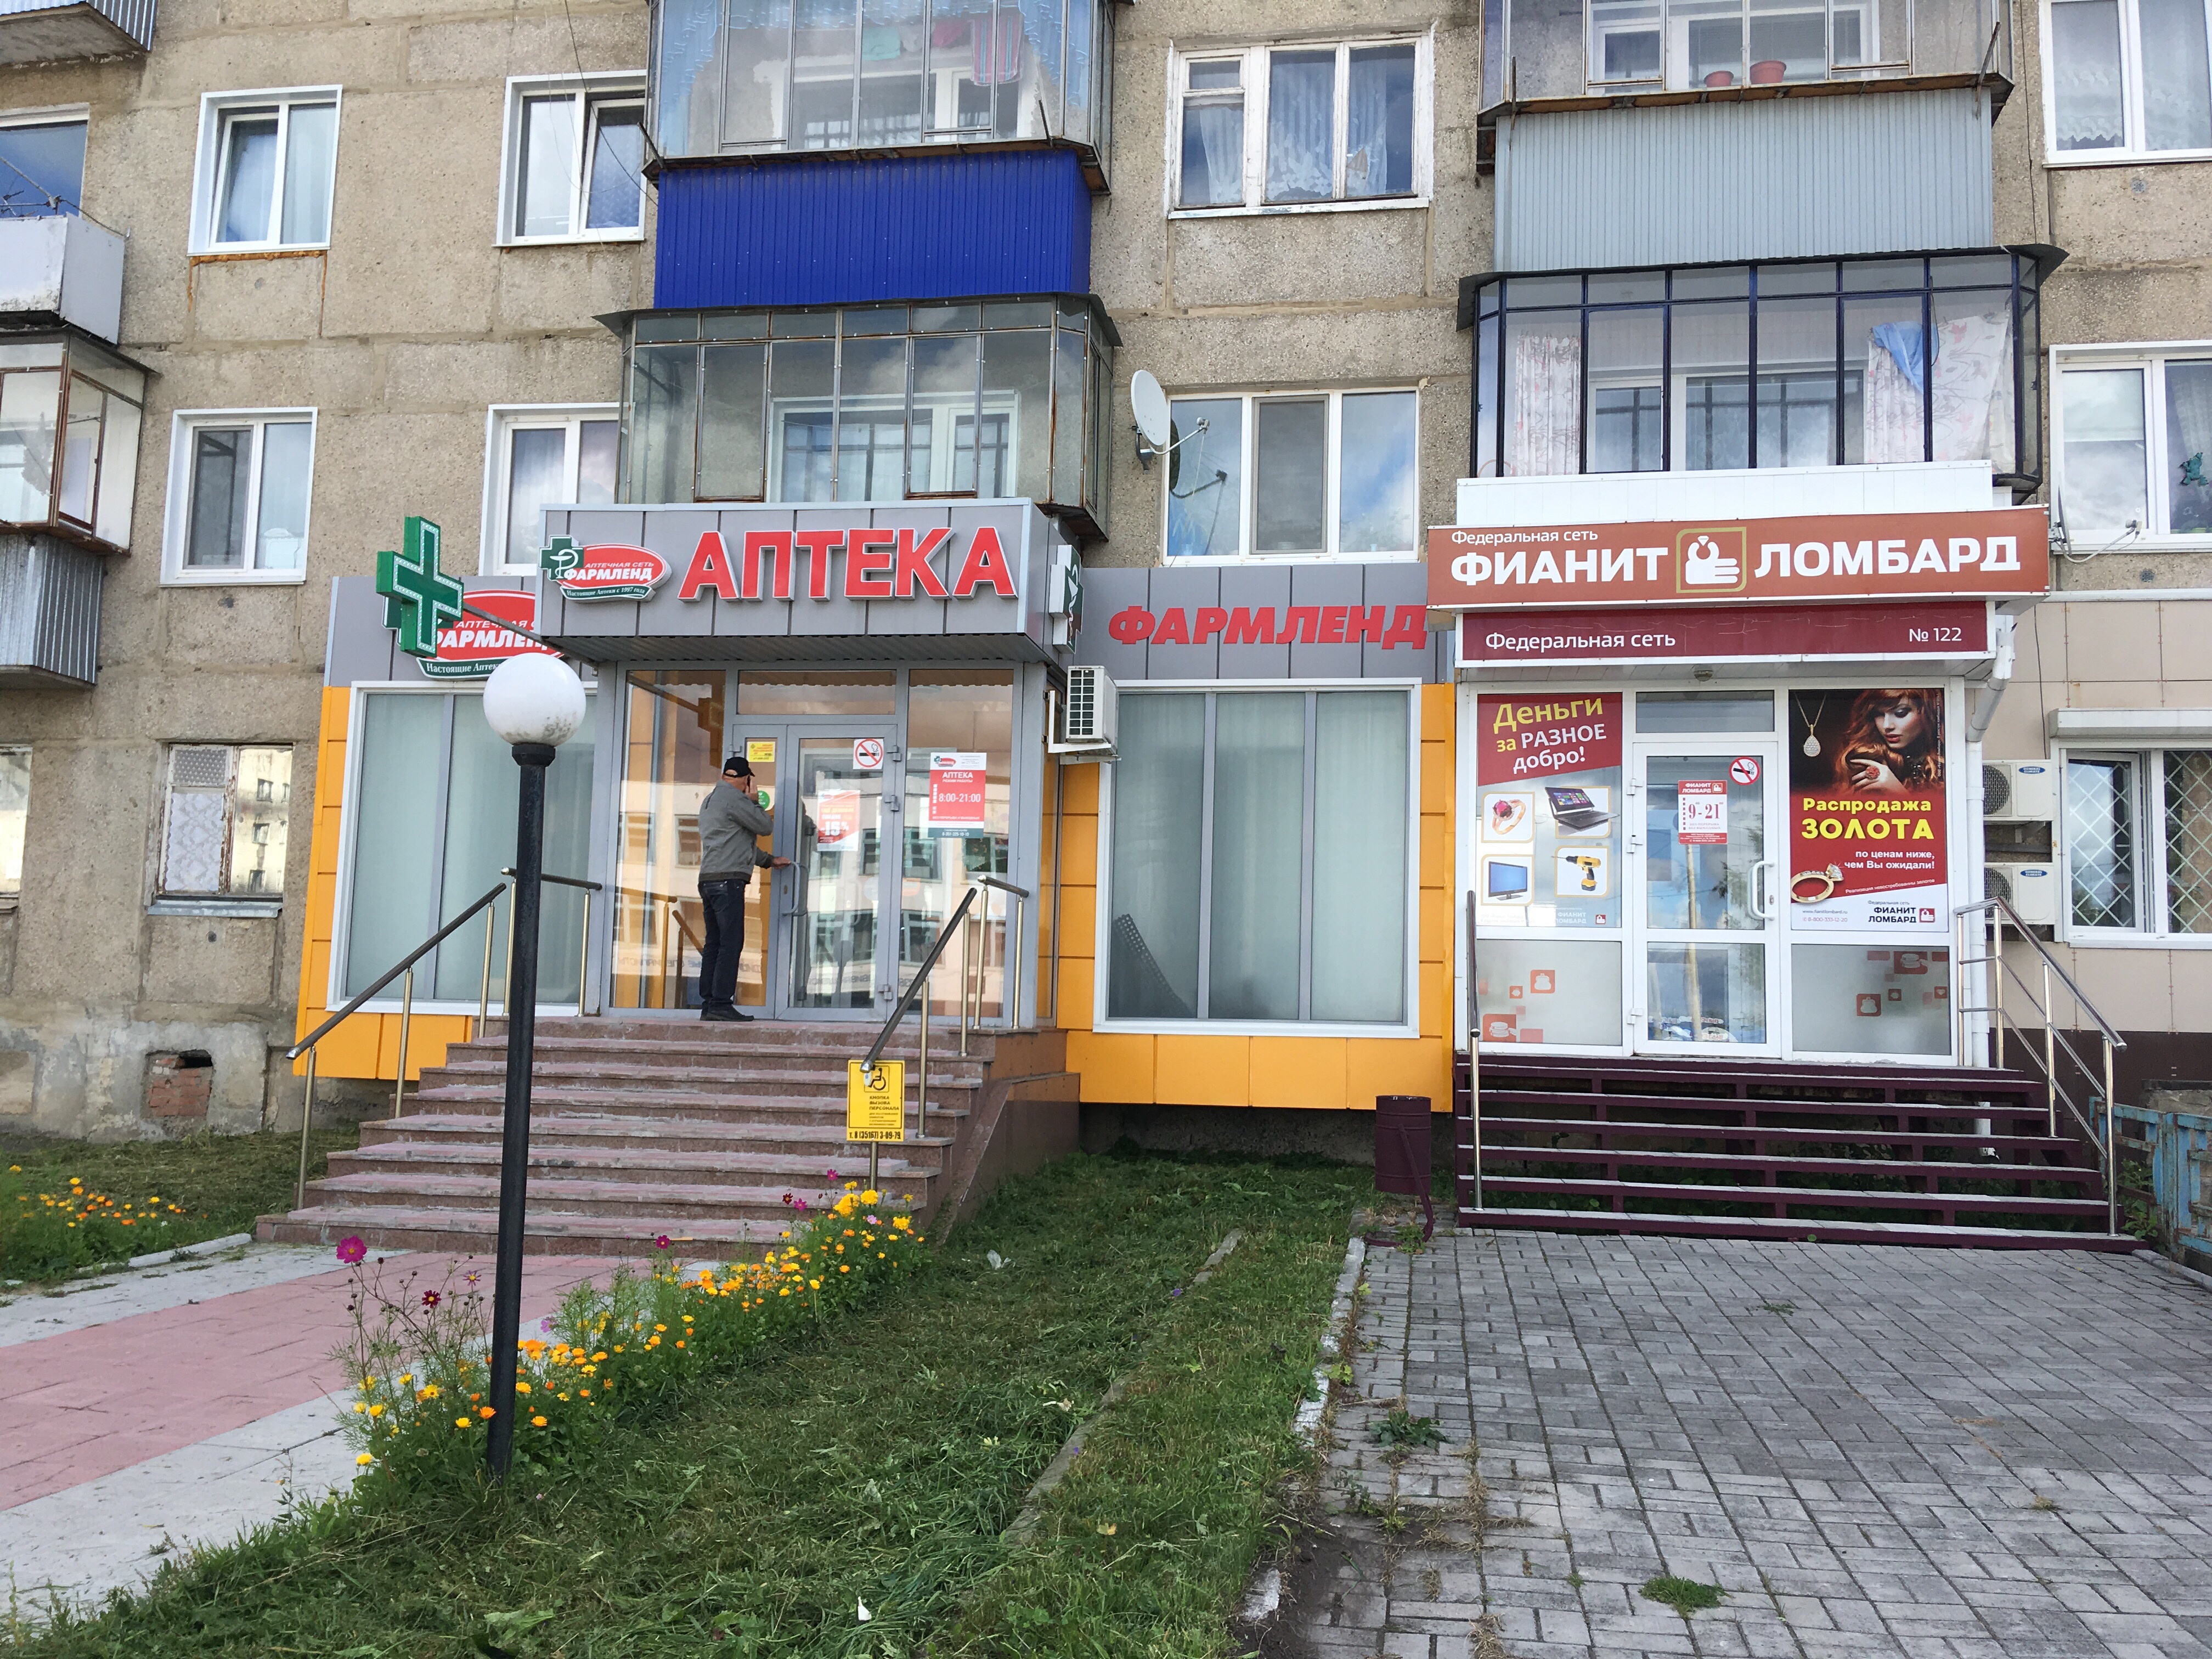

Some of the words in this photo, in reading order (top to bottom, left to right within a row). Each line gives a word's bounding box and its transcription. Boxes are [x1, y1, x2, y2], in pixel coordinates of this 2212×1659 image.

[1451, 530, 1559, 546] Федеральная
[1563, 530, 1599, 542] сеть
[677, 526, 1018, 601] АПТЕКА
[1451, 547, 1668, 586] ФИАНИТ
[1754, 536, 2021, 578] ЛОМБАРД
[564, 568, 652, 581] ФАРМЛЕНД
[1108, 605, 1427, 650] ФАРМЛЕНД
[1485, 632, 1624, 653] Федеральная
[1630, 633, 1676, 647] сеть
[1909, 628, 1929, 642] №
[1933, 627, 1962, 641] 122
[426, 663, 472, 673] Настоящие
[1493, 698, 1603, 735] Деньги
[1496, 738, 1516, 753] за
[1521, 724, 1607, 749] РАЗНОЕ
[1513, 746, 1585, 774] добро!
[939, 793, 981, 803] 8:00-21:00
[1803, 798, 1931, 814] Распродажа
[1801, 819, 1934, 839] ЗОЛОТА
[1886, 861, 1935, 870] ожидали!
